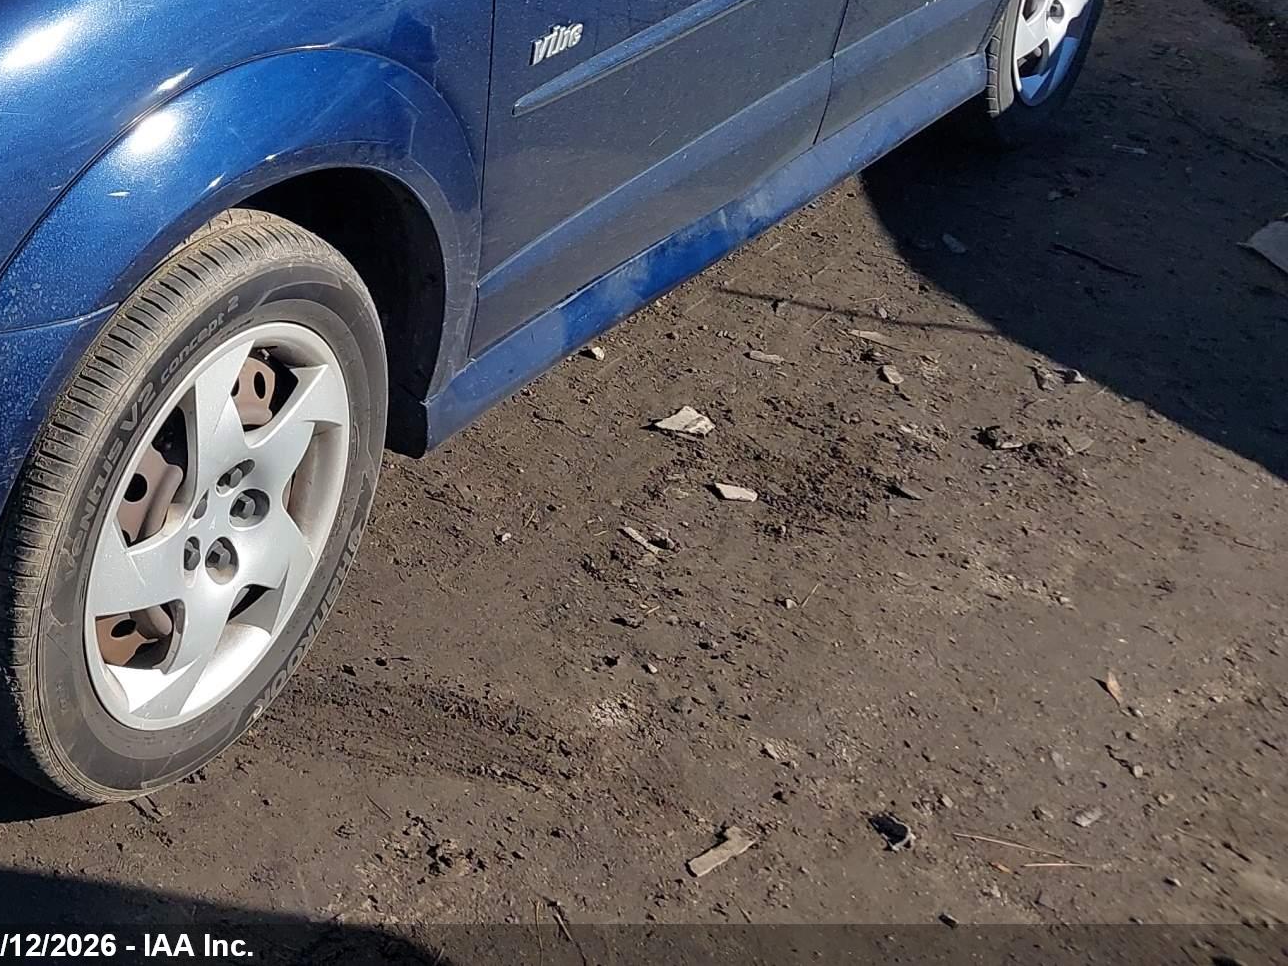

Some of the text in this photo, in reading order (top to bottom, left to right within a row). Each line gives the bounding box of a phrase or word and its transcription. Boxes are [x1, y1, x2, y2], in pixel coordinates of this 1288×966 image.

[120, 381, 157, 432] V2
[160, 313, 226, 381] concept
[226, 294, 240, 314] 2
